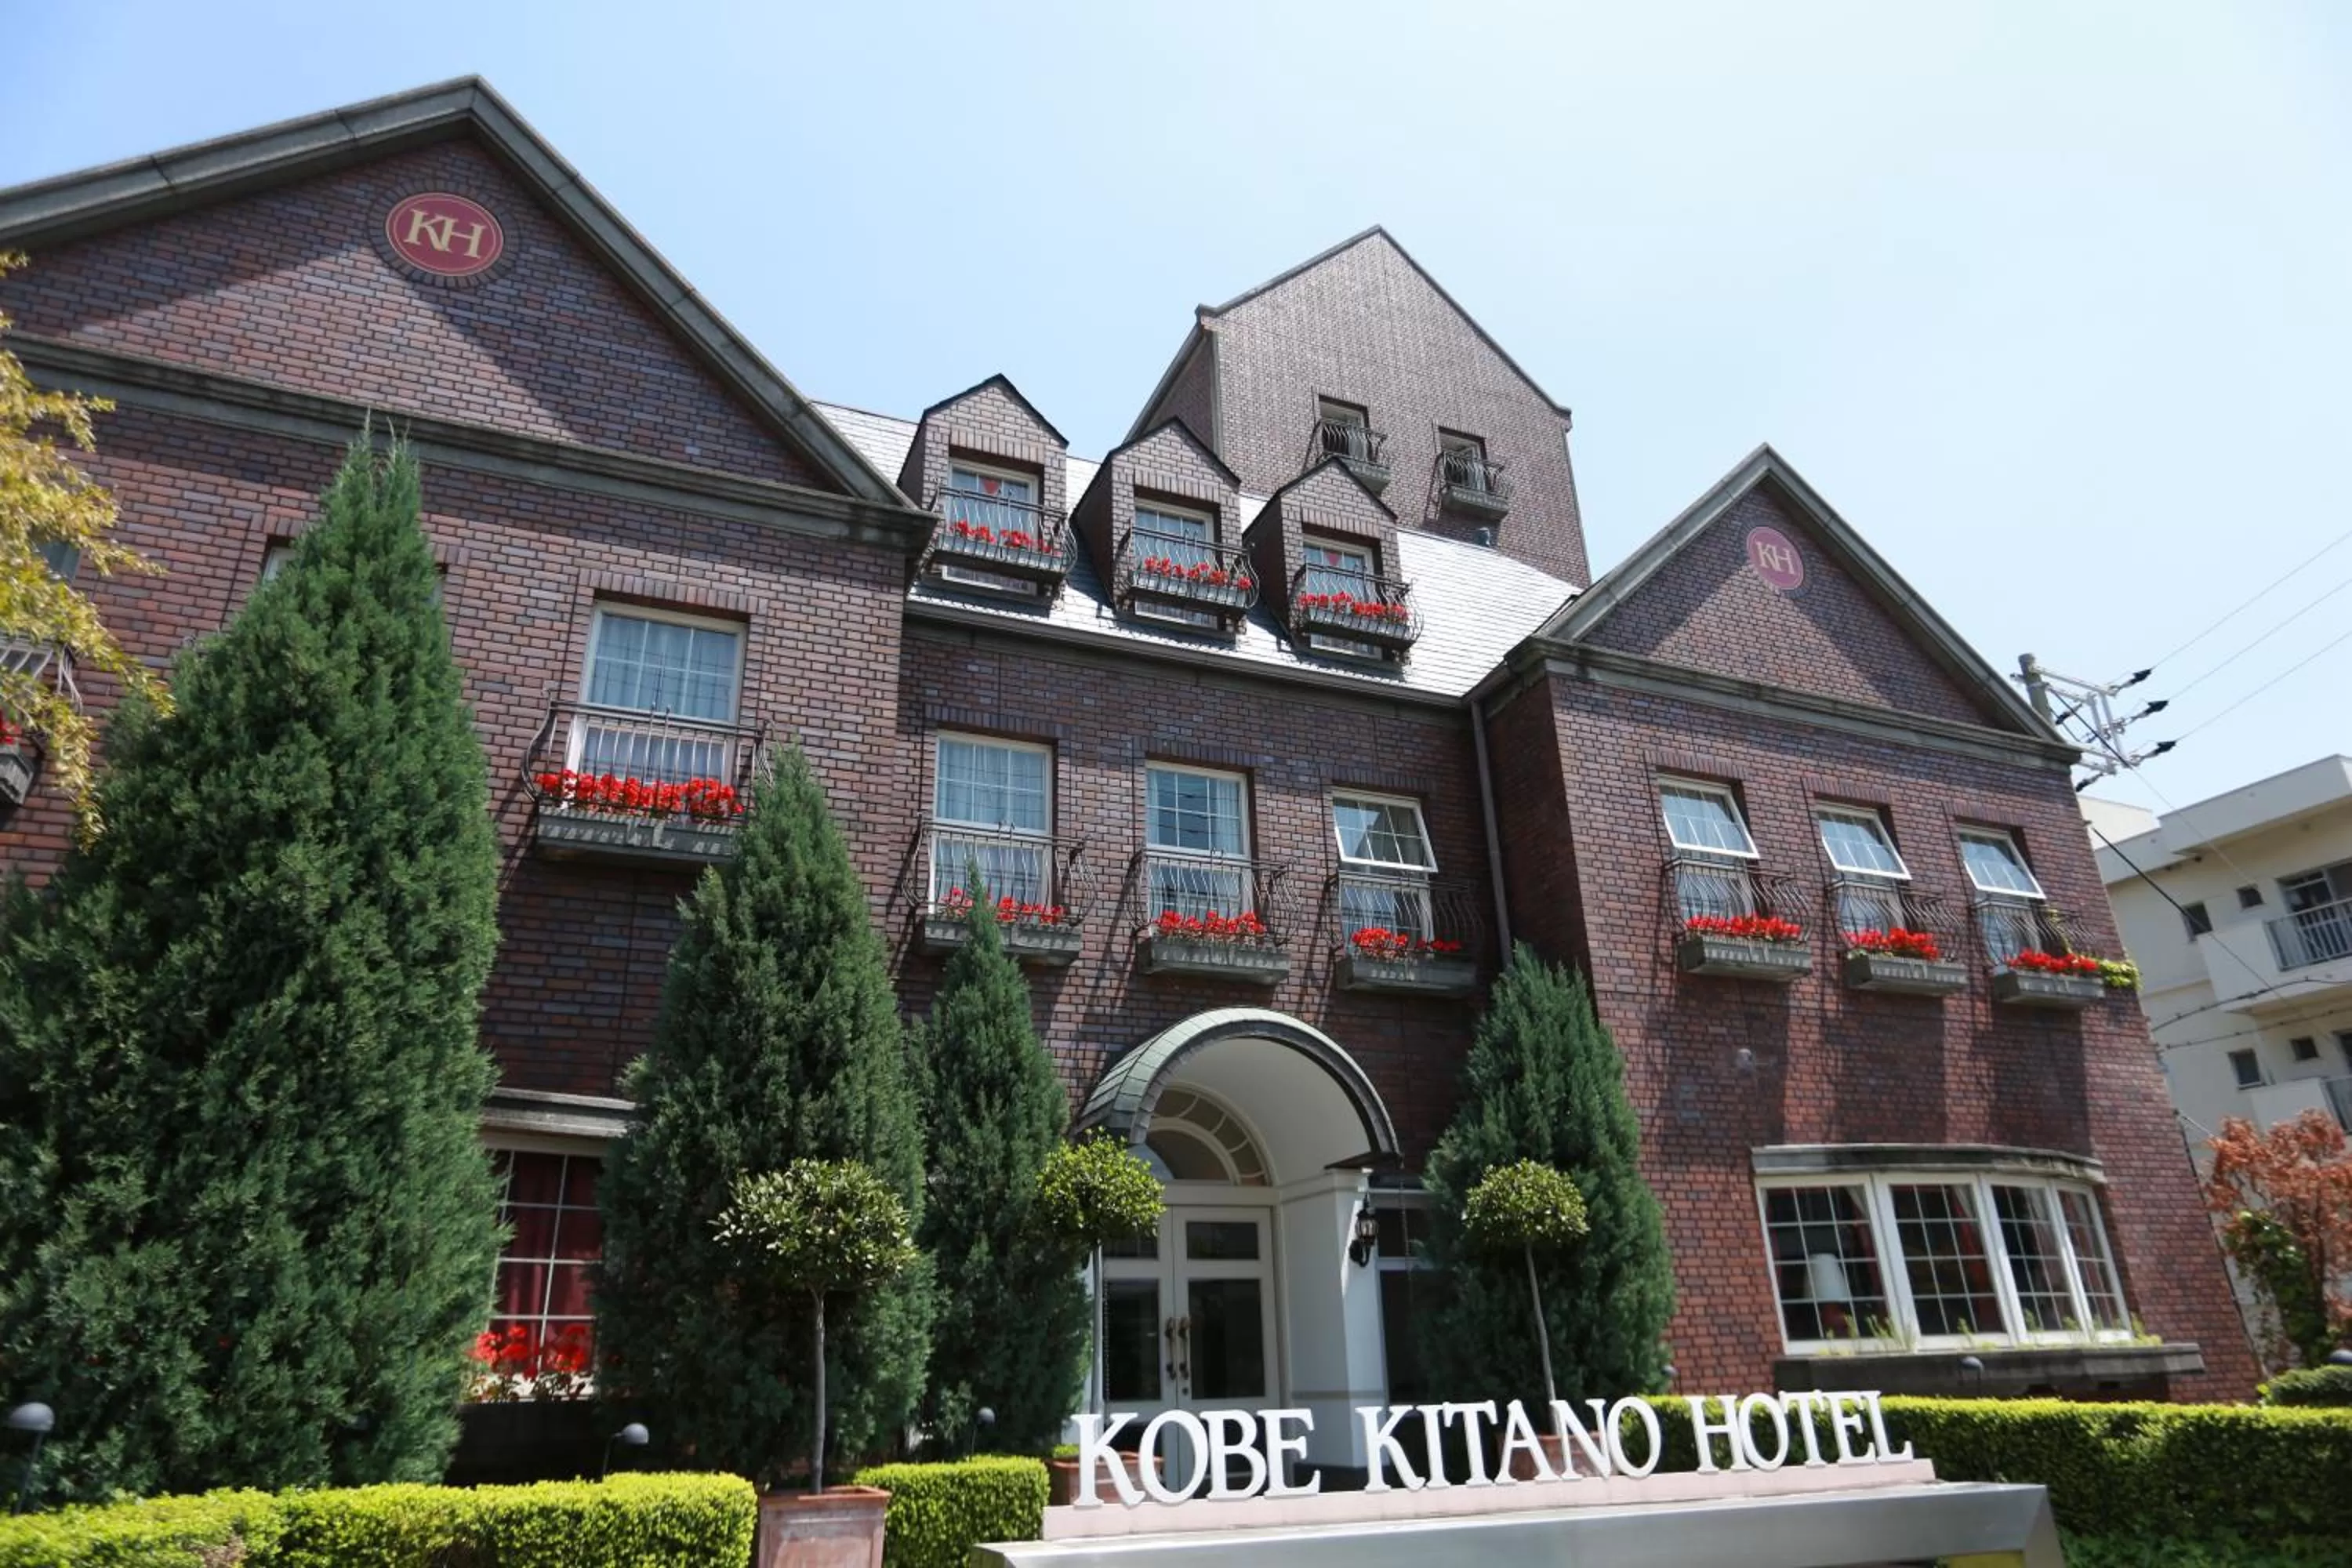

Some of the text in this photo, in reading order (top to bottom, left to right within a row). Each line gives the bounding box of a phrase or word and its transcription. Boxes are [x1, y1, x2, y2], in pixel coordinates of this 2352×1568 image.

[404, 209, 487, 259] KH
[1755, 541, 1794, 575] KH
[1071, 1389, 1913, 1508] KOBE KITANO HOTEL
